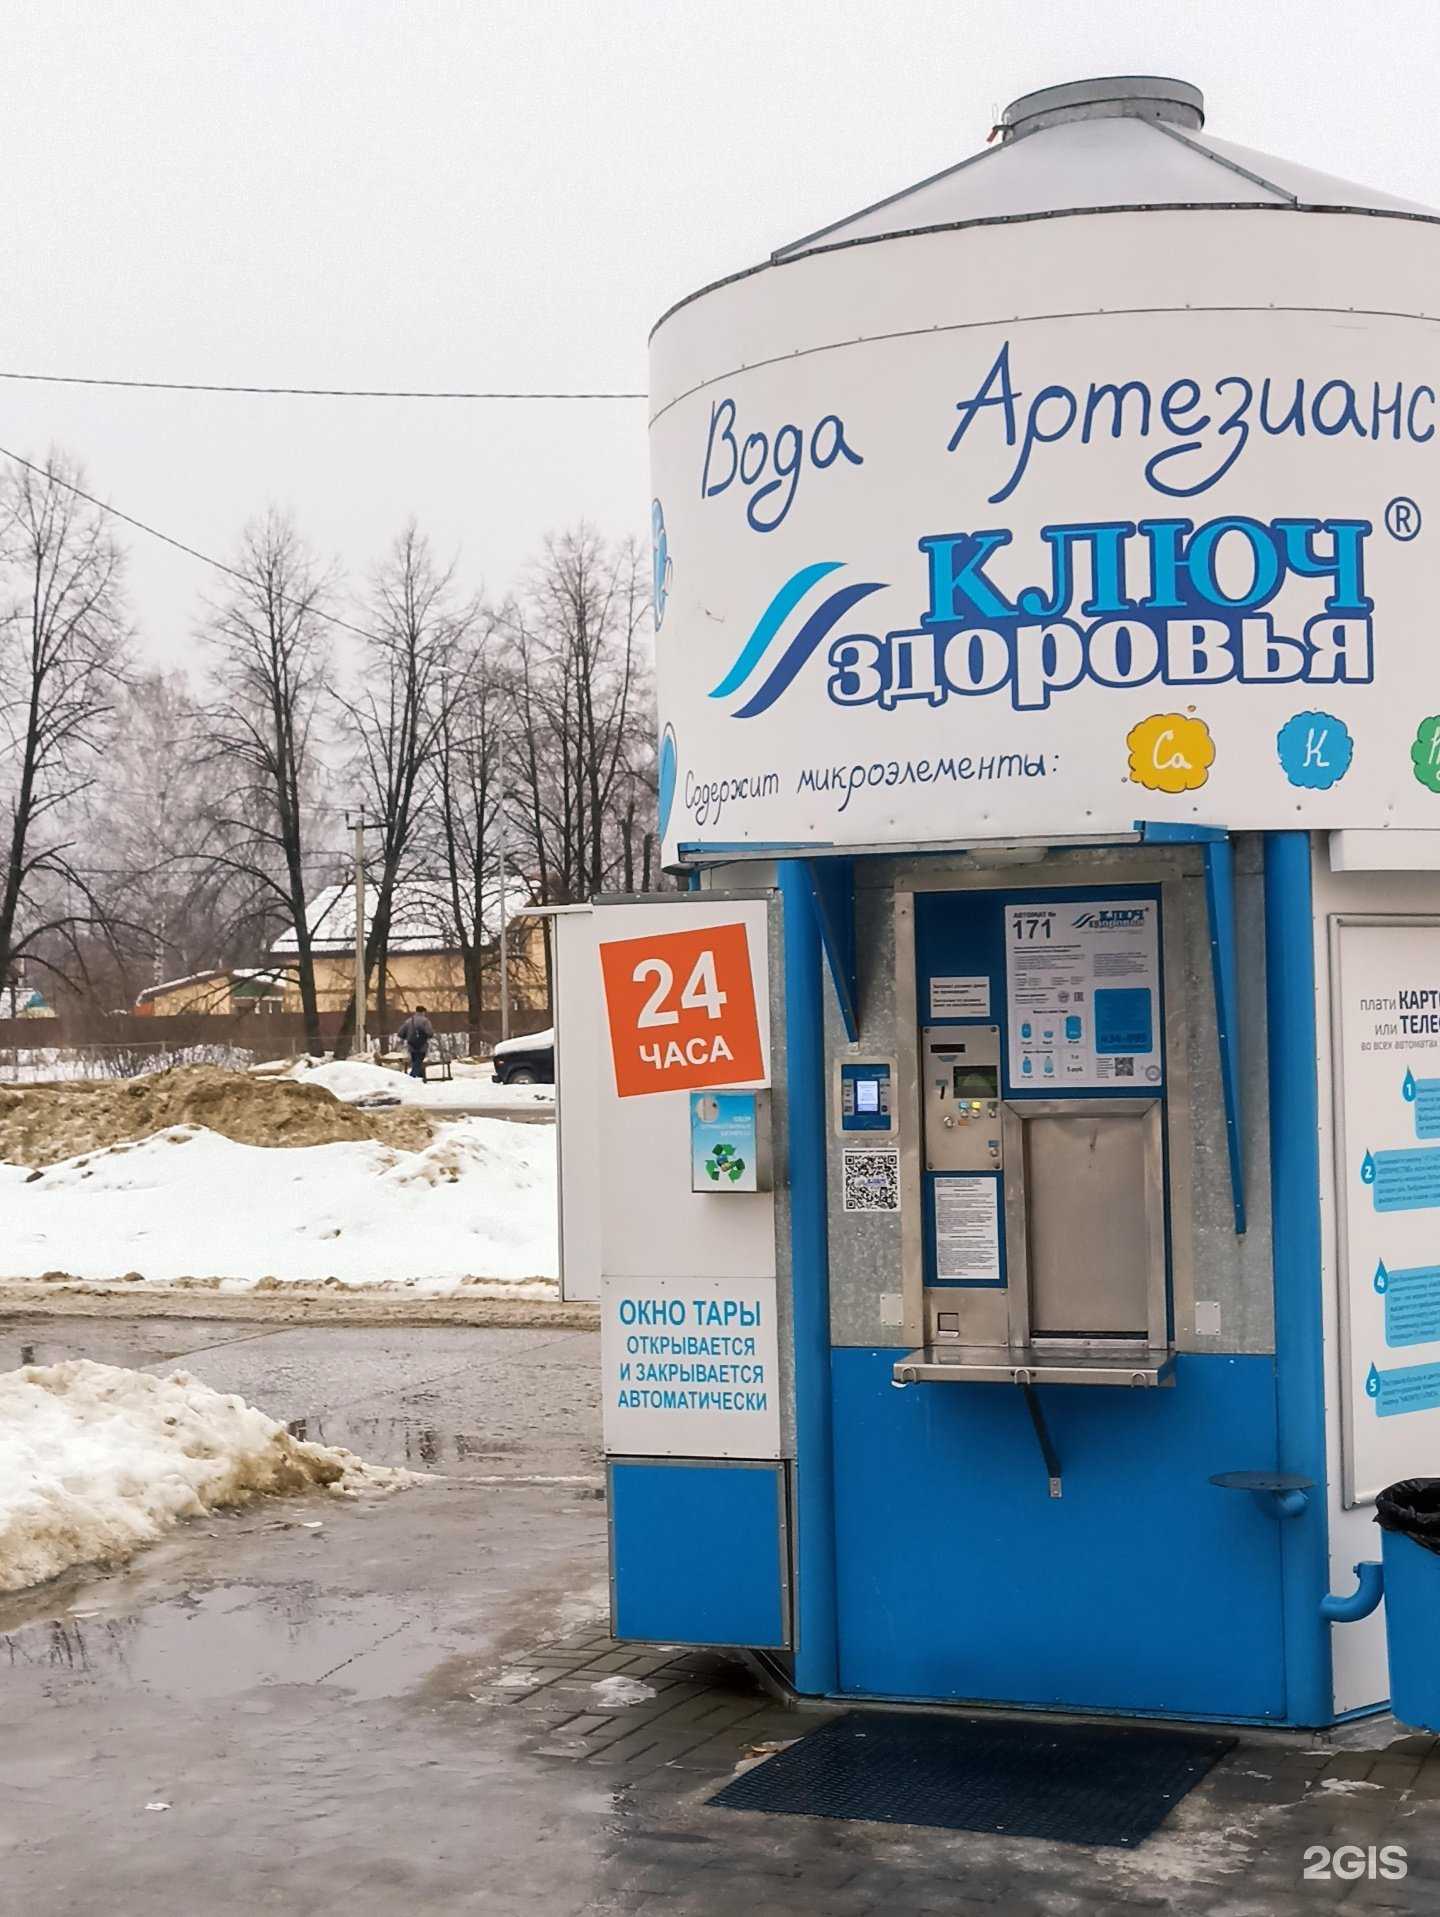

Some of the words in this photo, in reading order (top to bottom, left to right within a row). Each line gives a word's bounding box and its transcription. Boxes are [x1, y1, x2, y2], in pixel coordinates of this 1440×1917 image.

[701, 397, 863, 532] Вода
[947, 340, 1435, 504] Артезианс
[918, 515, 1373, 624] КЛЮЧ
[828, 616, 1374, 711] здоровья
[1152, 730, 1192, 770] Ca
[1302, 728, 1329, 767] K
[684, 769, 780, 826] Содержит
[796, 751, 1060, 812] микроэлементы:
[1013, 919, 1051, 940] 171
[631, 949, 728, 1030] 24
[1360, 998, 1397, 1011] плати
[1399, 990, 1440, 1009] КАРТ
[1375, 1024, 1398, 1035] или
[1400, 1015, 1440, 1034] ТЕЛЕ
[639, 1035, 734, 1071] ЧАСА
[1373, 1041, 1392, 1050] всех
[1406, 1084, 1412, 1097] 1
[1365, 1166, 1372, 1179] 2
[1377, 1276, 1385, 1288] 4
[619, 1299, 686, 1327] ОКНО
[692, 1299, 761, 1327] ТАРЫ
[627, 1335, 755, 1356] ОТКРЫВАЕТСЯ
[620, 1363, 632, 1383] И
[636, 1362, 764, 1385] ЗАКРЫВАЕТСЯ
[1370, 1379, 1377, 1392] 5
[618, 1389, 767, 1413] АВТОМАТИЧЕСКИ
